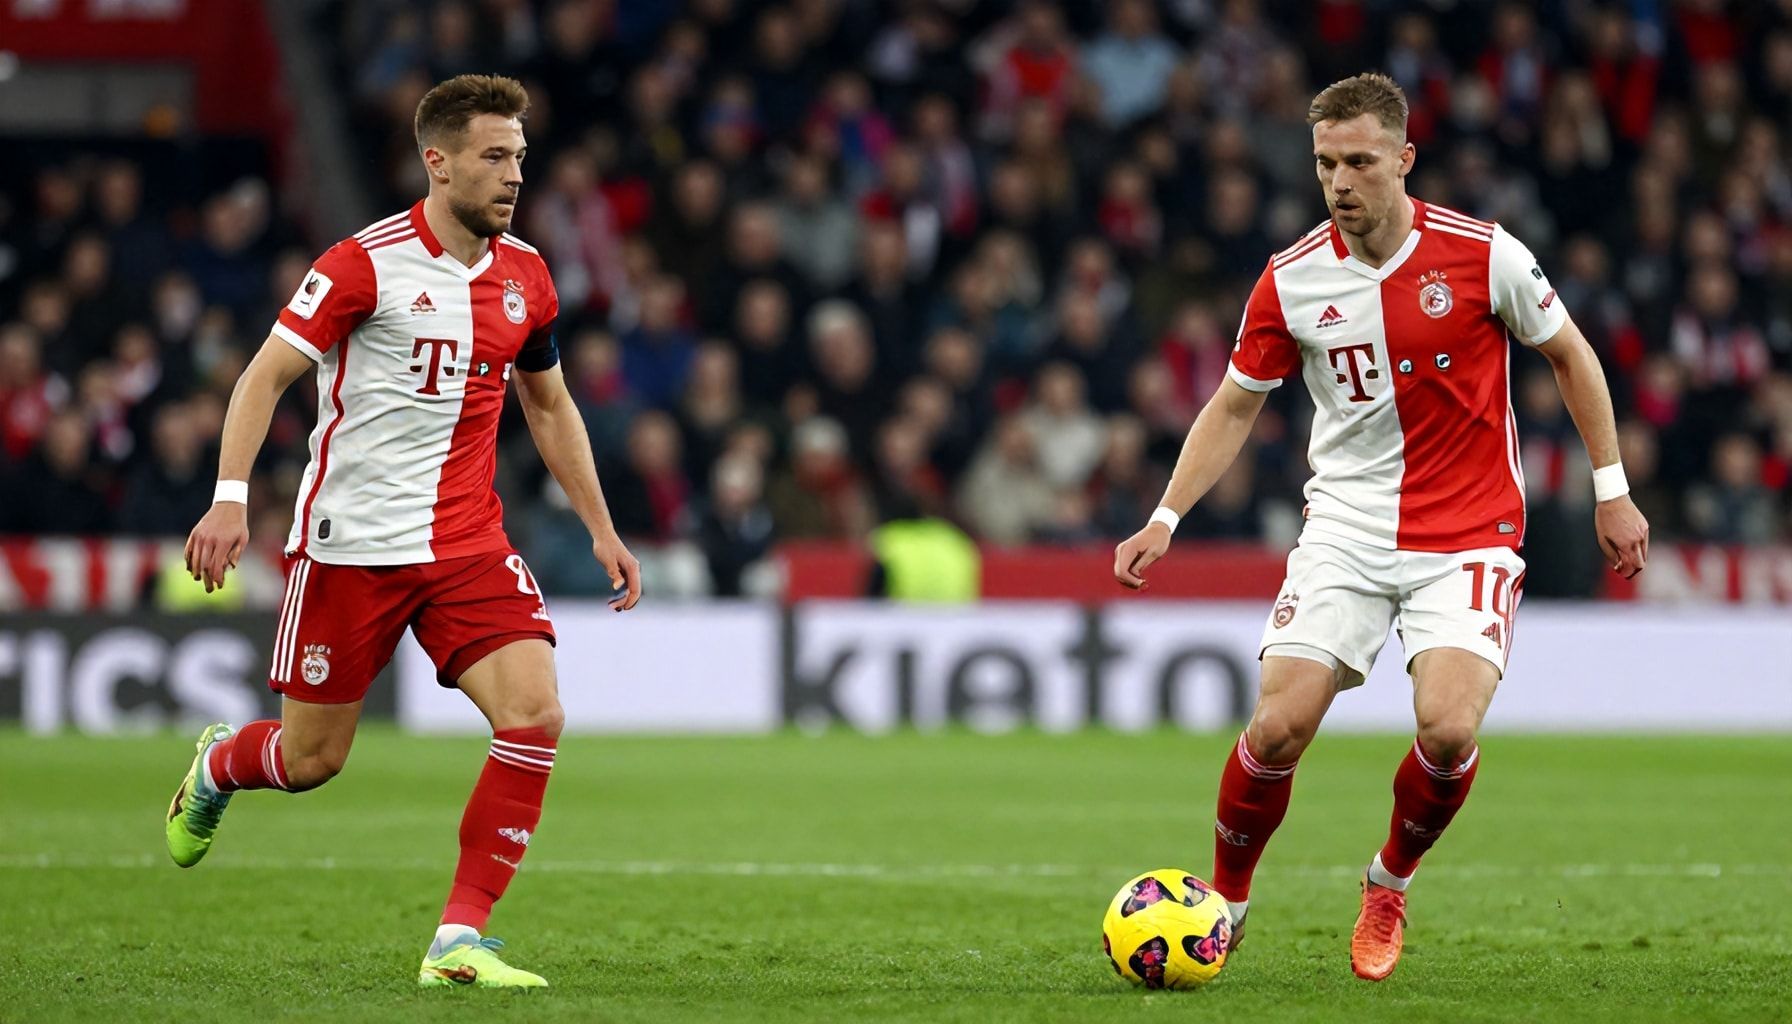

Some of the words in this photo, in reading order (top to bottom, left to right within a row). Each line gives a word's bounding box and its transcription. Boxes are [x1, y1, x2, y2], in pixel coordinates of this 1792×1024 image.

[410, 337, 459, 396] T
[1327, 342, 1379, 403] T
[0, 626, 262, 736] ICS
